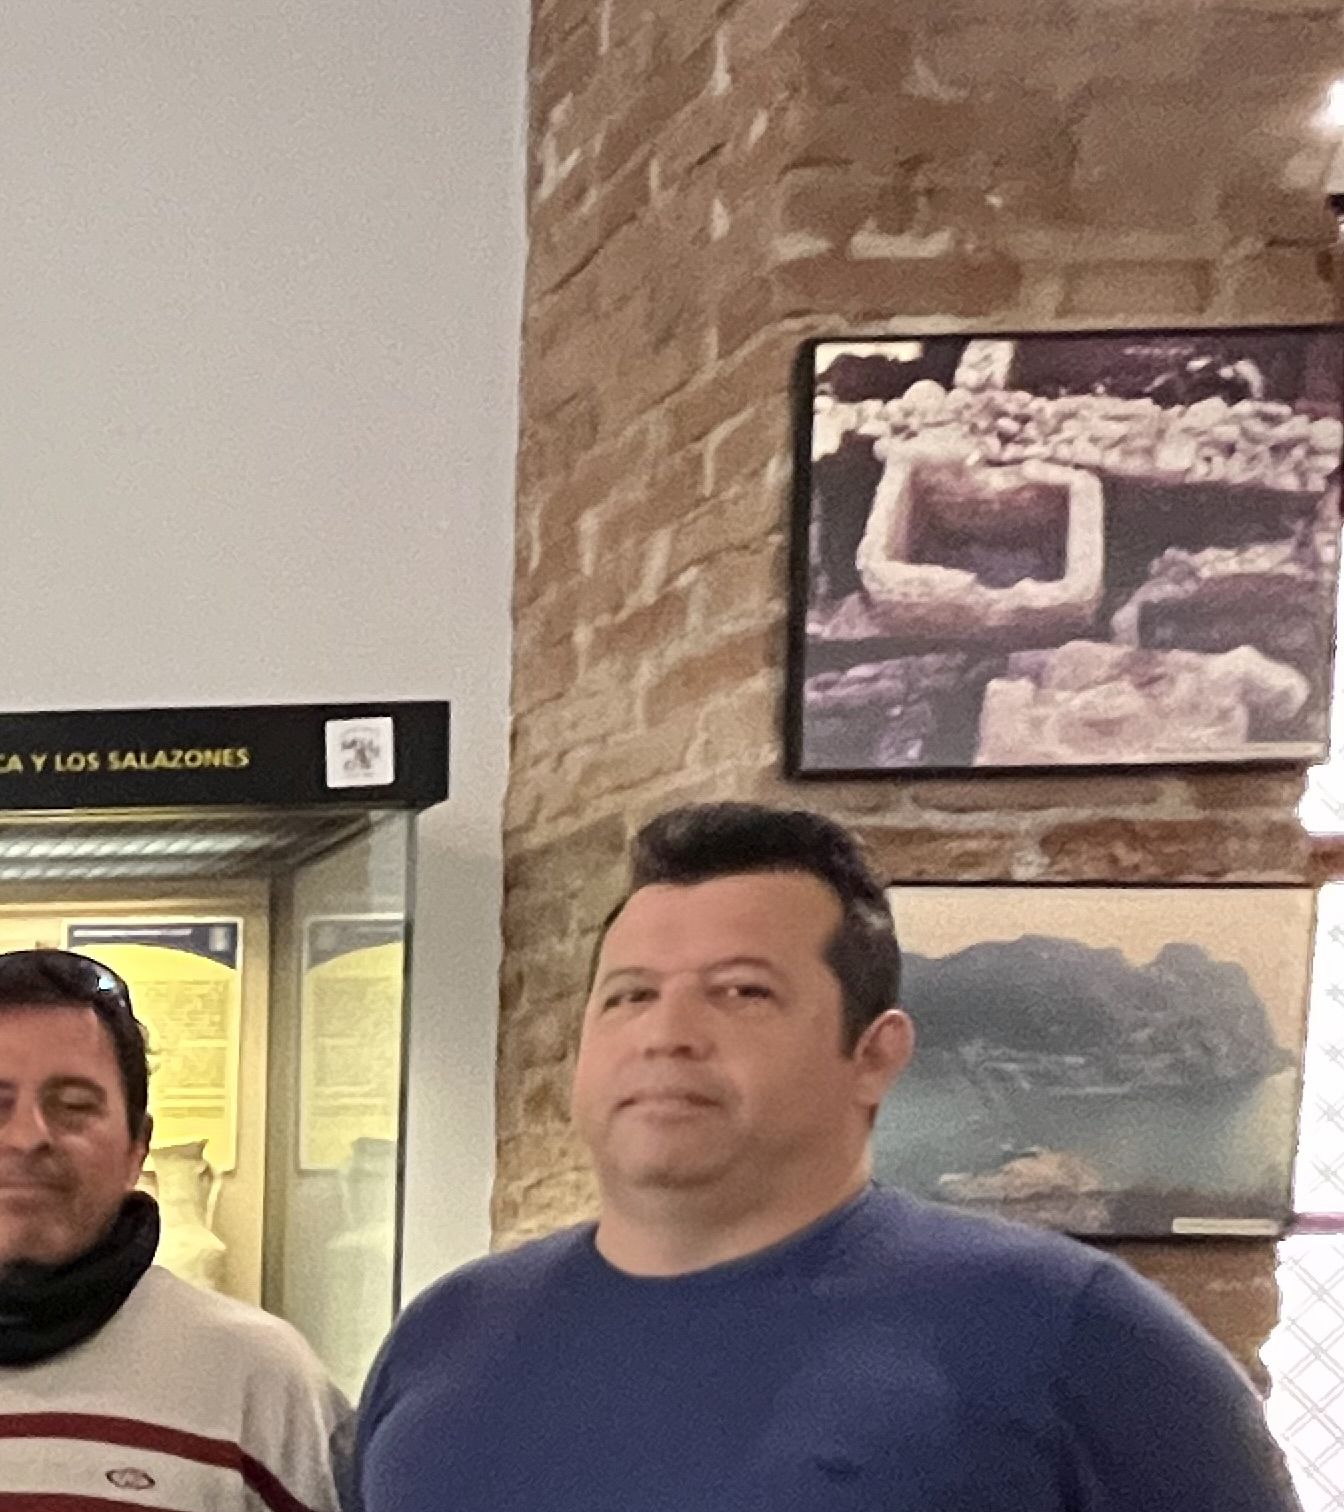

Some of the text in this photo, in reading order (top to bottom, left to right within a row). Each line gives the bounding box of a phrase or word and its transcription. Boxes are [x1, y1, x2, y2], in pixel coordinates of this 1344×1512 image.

[30, 753, 47, 773] Y
[56, 752, 100, 772] LOS
[107, 748, 251, 771] SALAZONES
